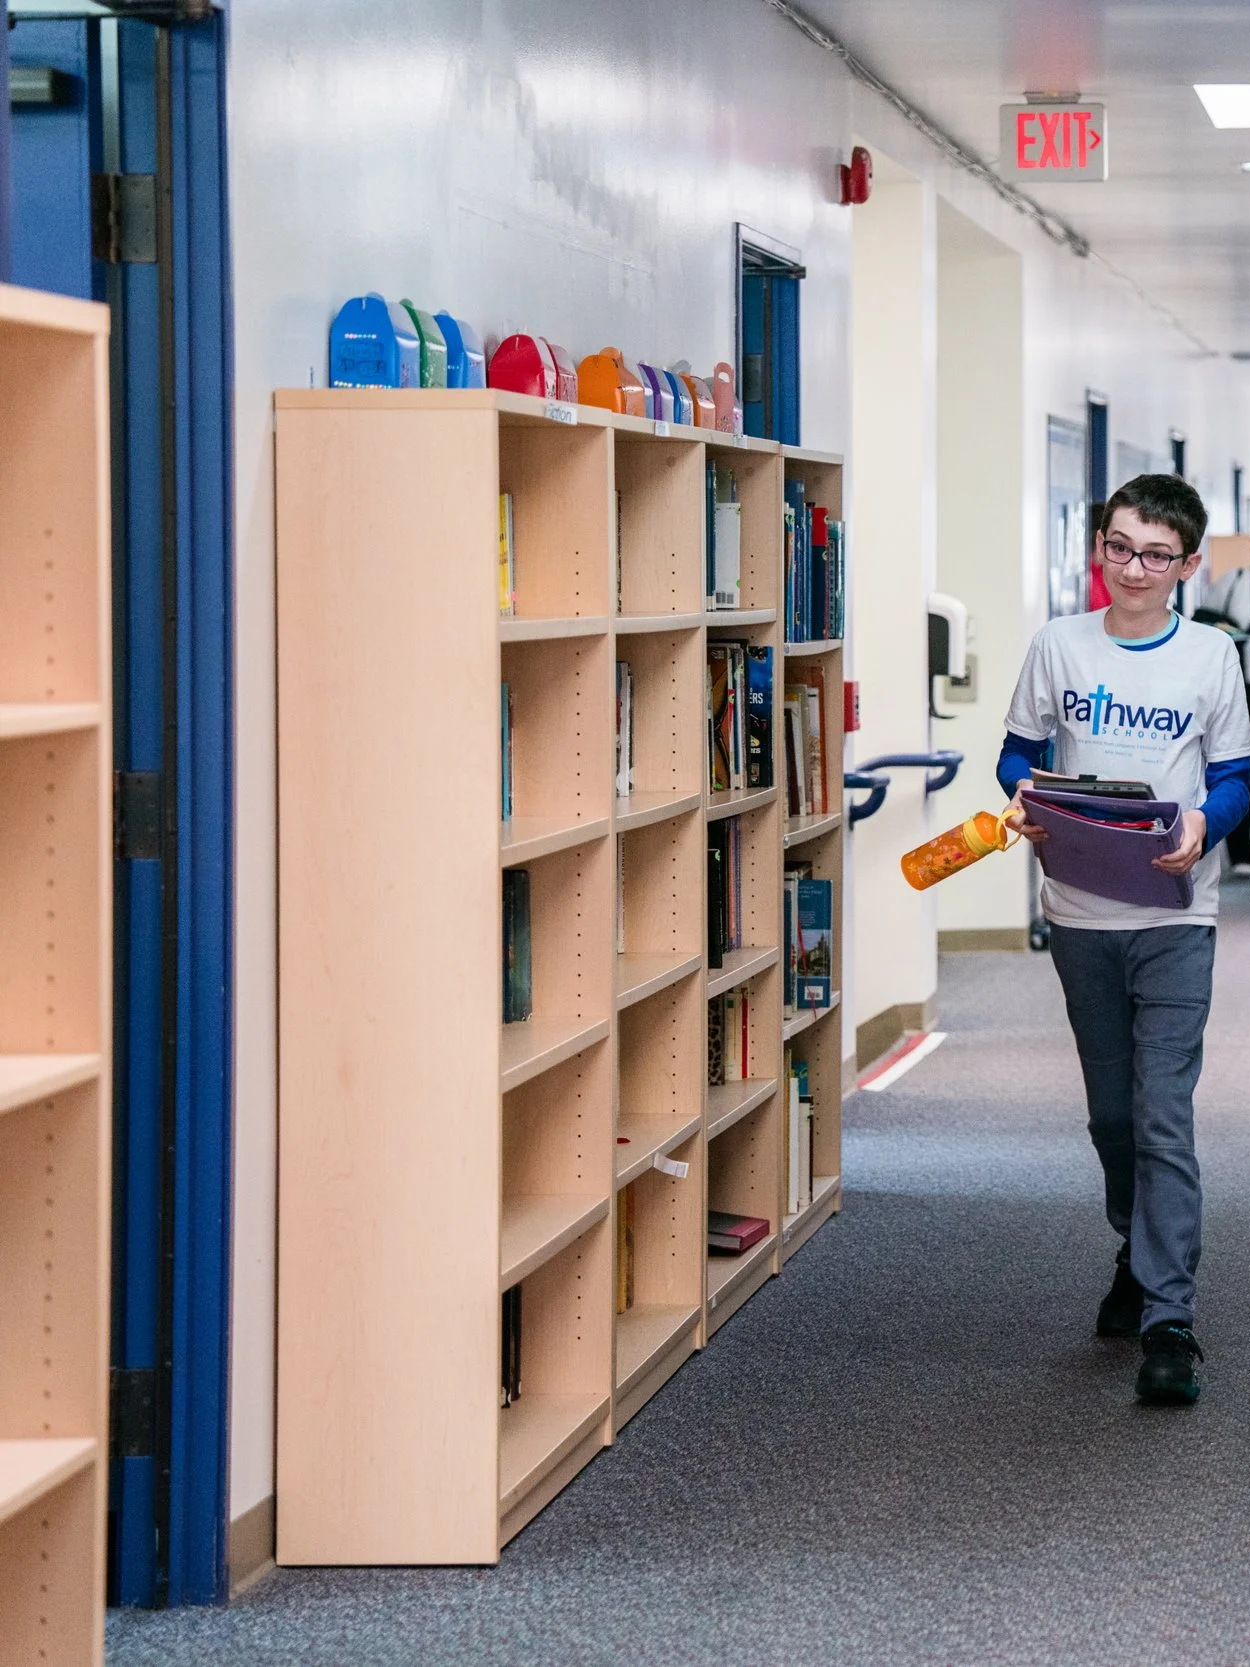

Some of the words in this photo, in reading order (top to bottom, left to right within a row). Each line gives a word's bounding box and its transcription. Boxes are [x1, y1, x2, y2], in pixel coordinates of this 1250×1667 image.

[1016, 112, 1092, 169] EXIT
[1063, 683, 1193, 740] Pathway
[1101, 726, 1168, 741] SCHOOL
